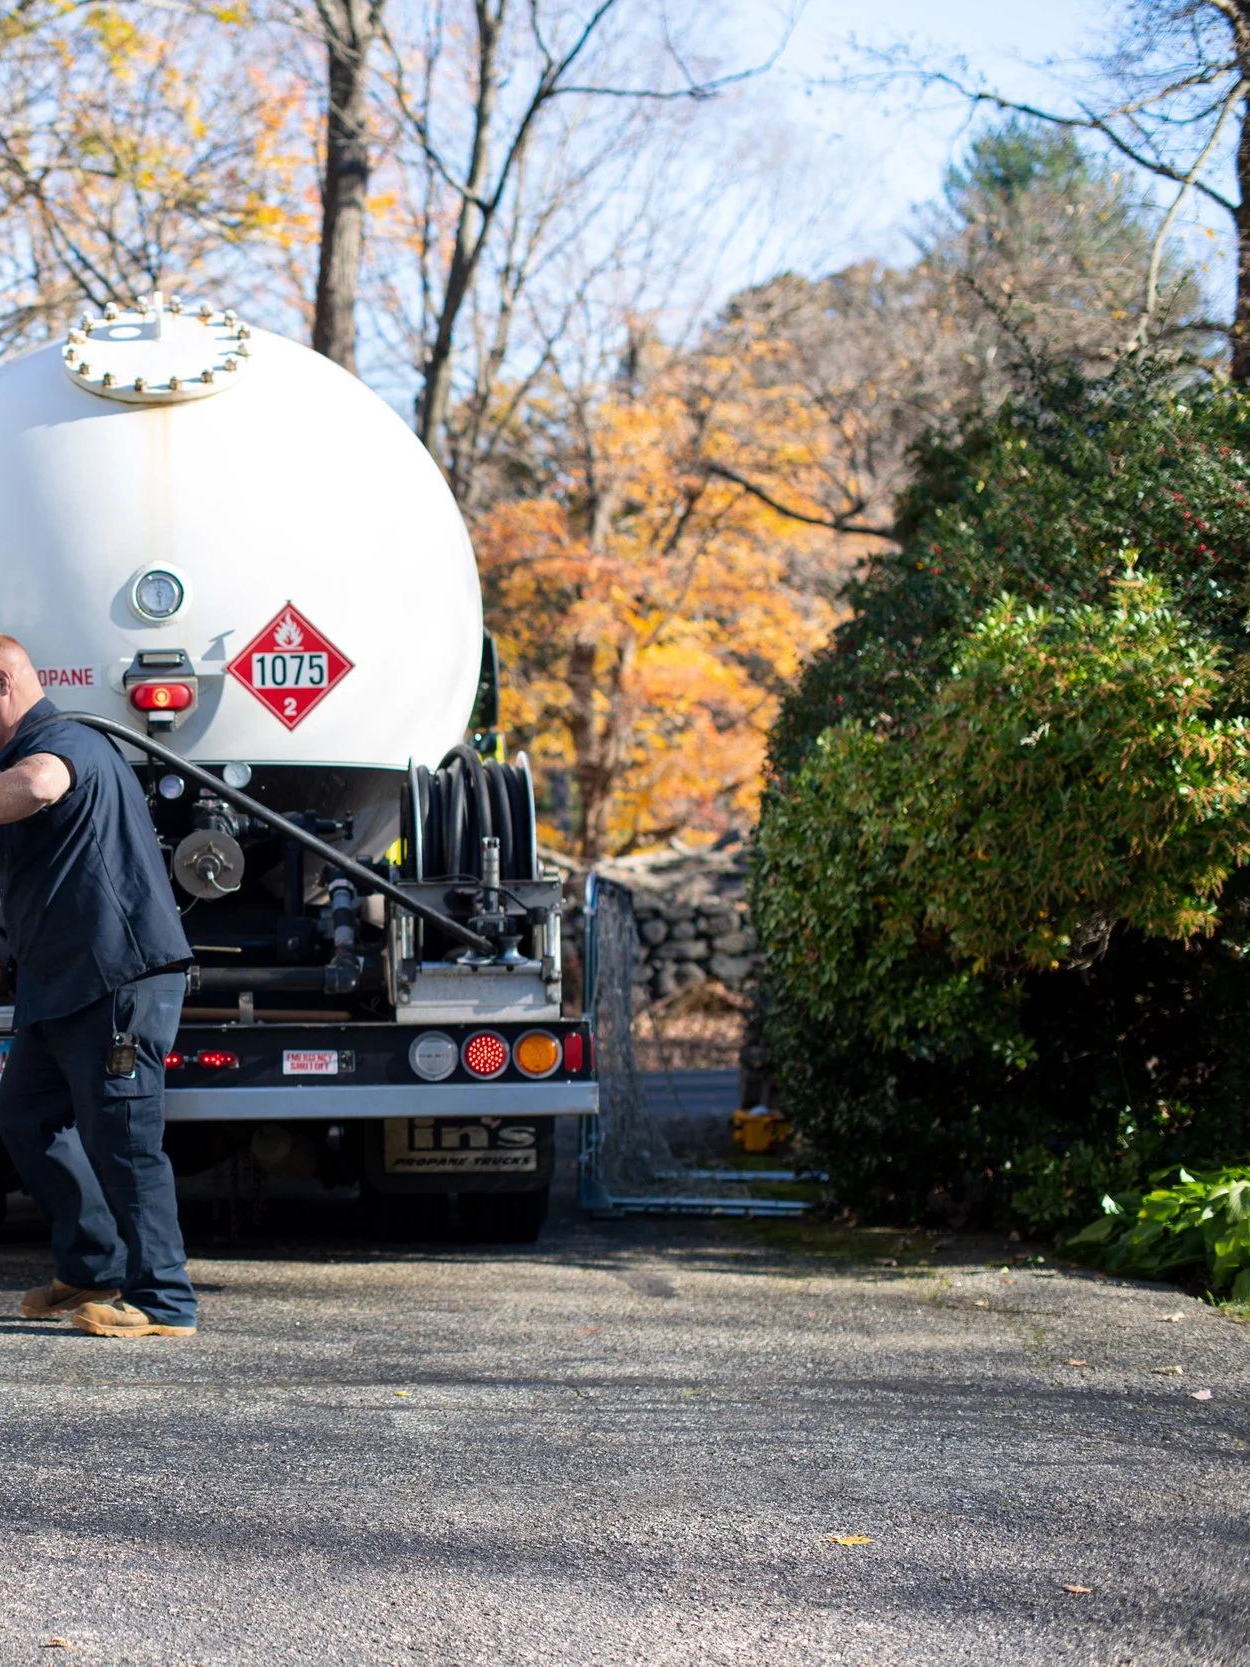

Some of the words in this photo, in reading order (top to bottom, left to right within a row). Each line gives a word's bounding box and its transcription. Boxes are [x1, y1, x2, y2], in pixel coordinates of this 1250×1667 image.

[256, 654, 325, 686] 1075
[283, 697, 298, 716] 2
[286, 1053, 335, 1062] EMERGENCY
[393, 1156, 468, 1167] PROPANE
[473, 1155, 532, 1166] TRUCKS
